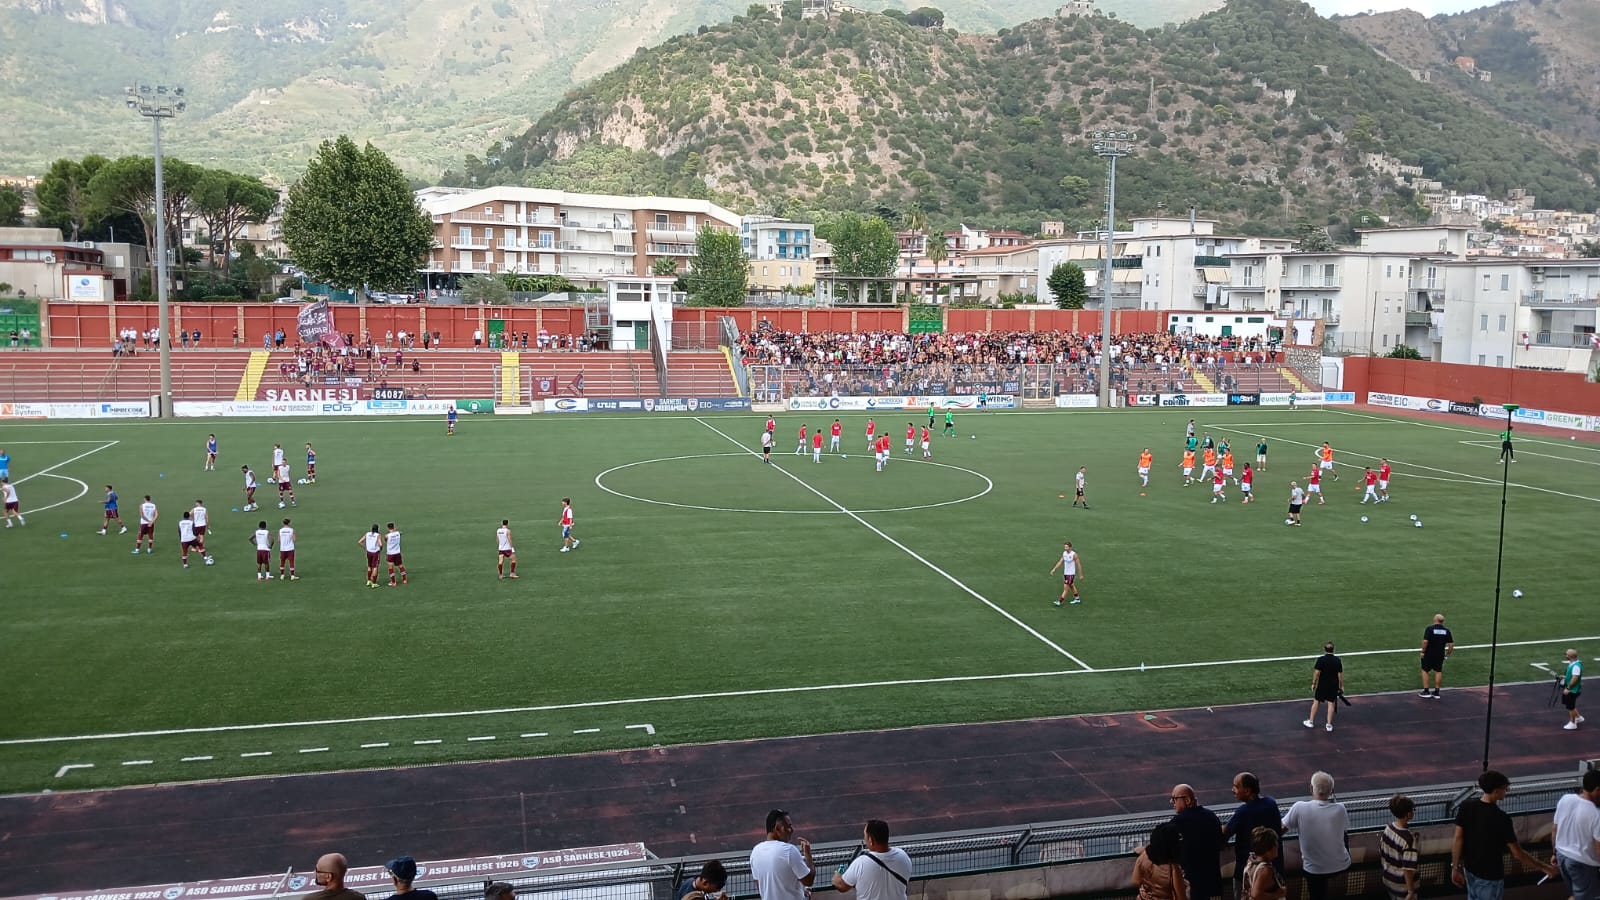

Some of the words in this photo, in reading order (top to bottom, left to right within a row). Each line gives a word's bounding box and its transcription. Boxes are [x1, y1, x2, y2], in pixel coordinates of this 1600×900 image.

[266, 389, 358, 401] SARNESI
[375, 390, 403, 399] 84087
[543, 855, 562, 864] ASD
[563, 851, 604, 862] SARNESE
[429, 867, 449, 875] ASD
[450, 862, 494, 873] SARNESE
[495, 860, 520, 869] 1926
[134, 890, 162, 899] 1926
[185, 887, 208, 896] ASD
[209, 882, 257, 894] SARNESE
